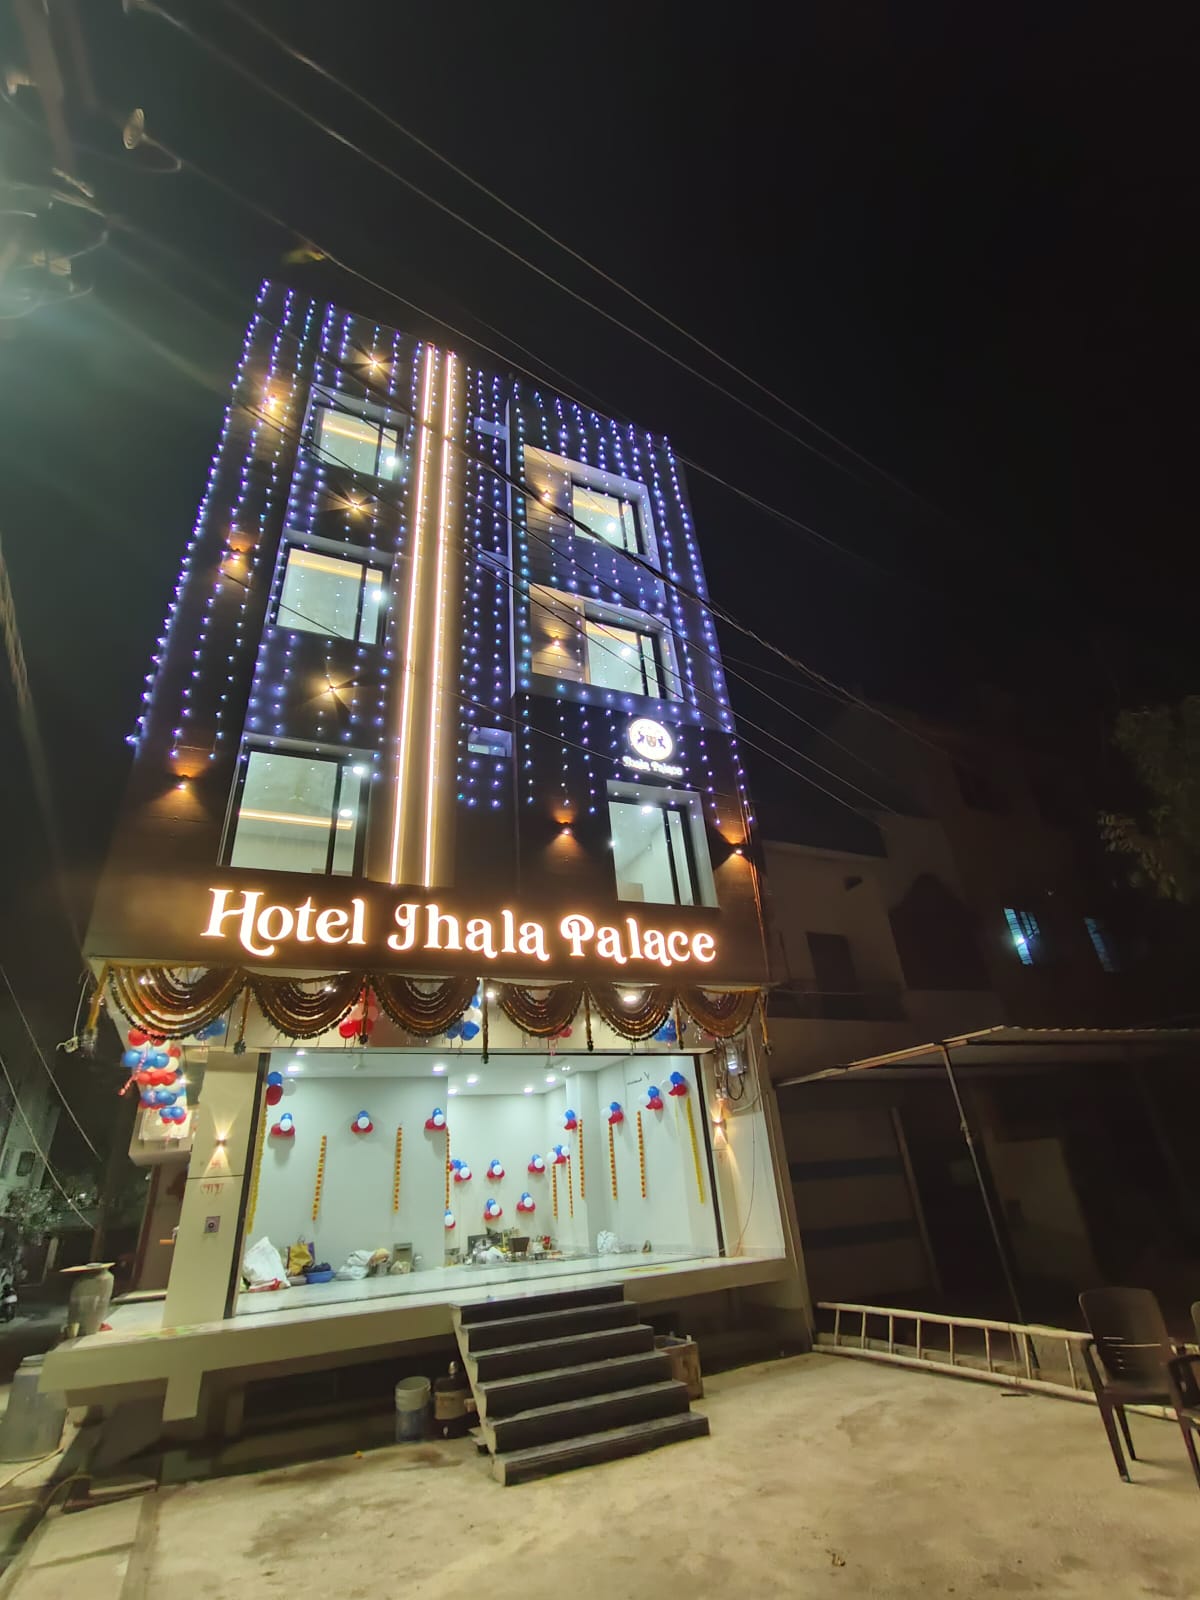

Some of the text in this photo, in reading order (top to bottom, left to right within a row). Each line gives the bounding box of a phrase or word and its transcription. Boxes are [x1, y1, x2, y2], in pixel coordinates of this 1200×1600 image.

[200, 888, 716, 966] Hotel Jhala Palace
